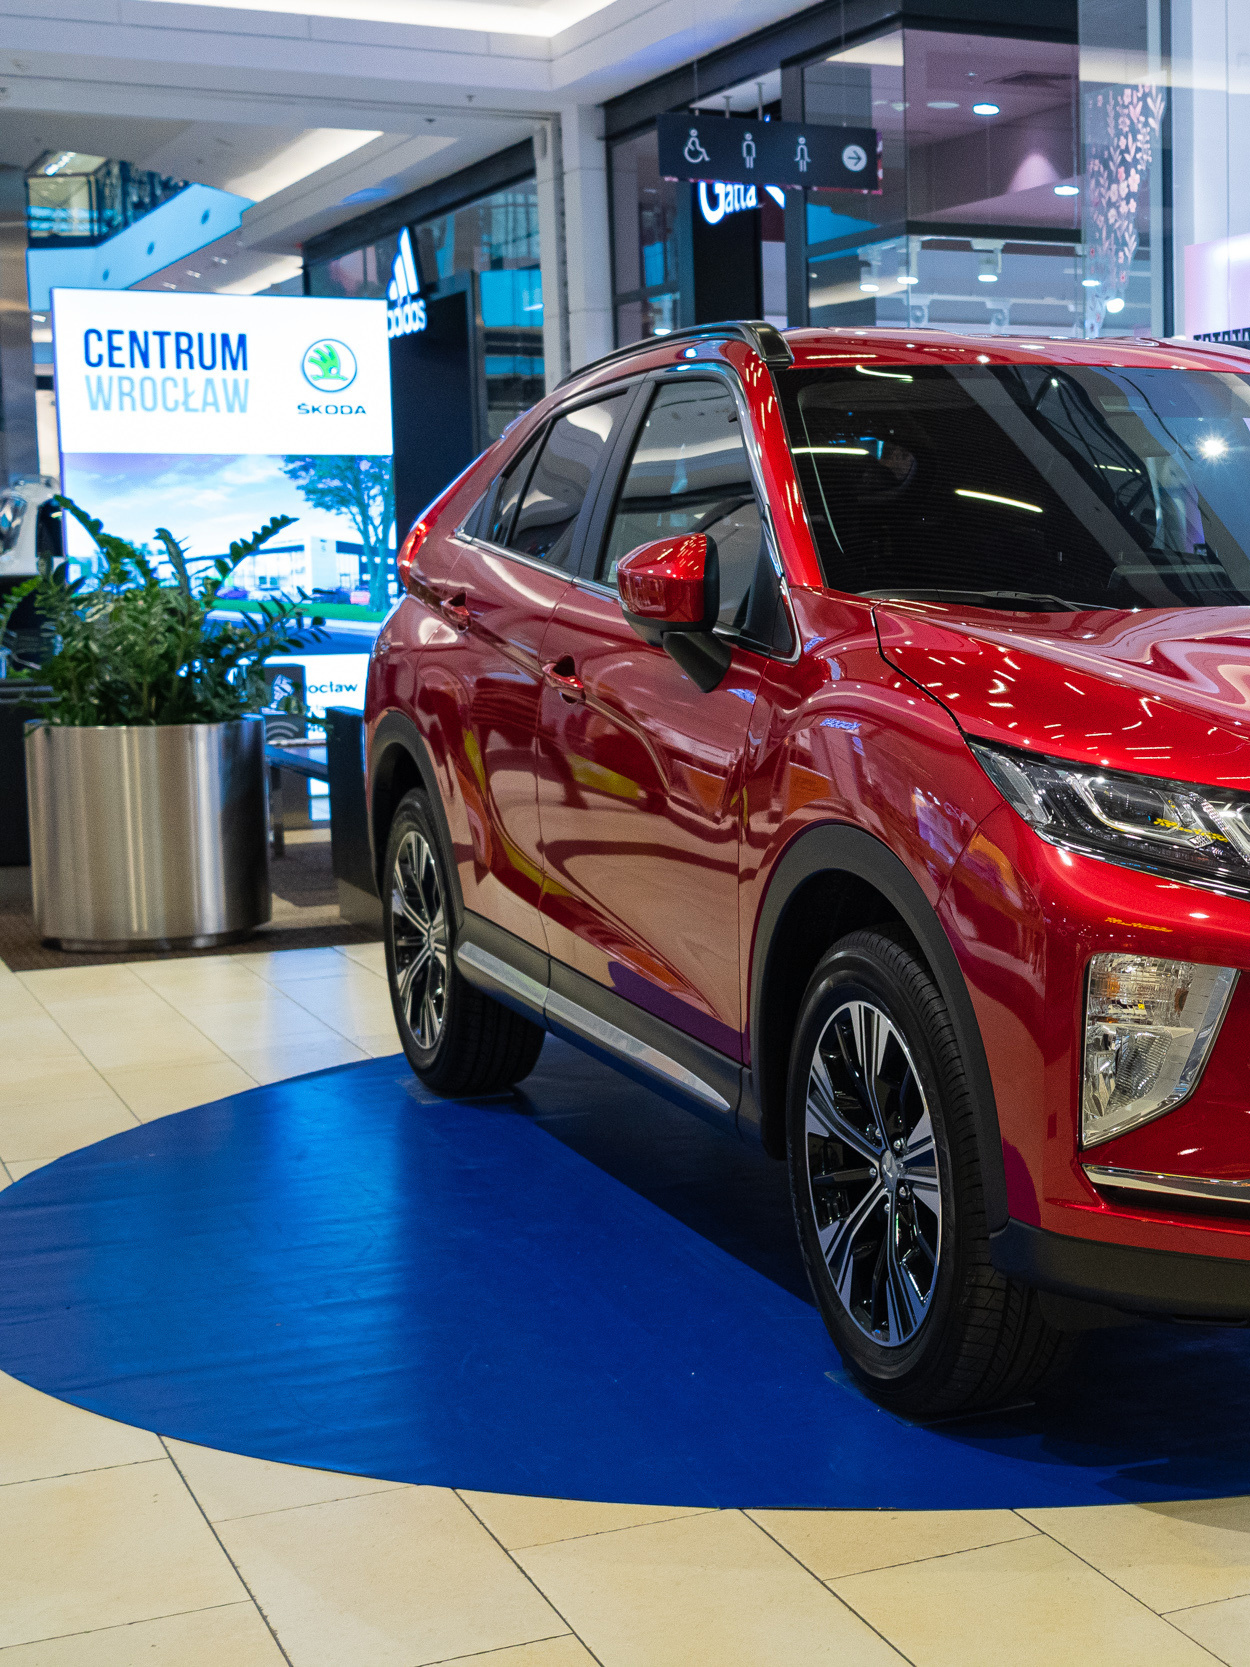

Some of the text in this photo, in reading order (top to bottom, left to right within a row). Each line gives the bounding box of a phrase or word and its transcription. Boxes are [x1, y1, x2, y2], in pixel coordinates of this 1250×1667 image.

[83, 328, 249, 371] CENTRUM
[84, 375, 250, 413] WROCŁAW
[297, 402, 367, 415] ŠKODA
